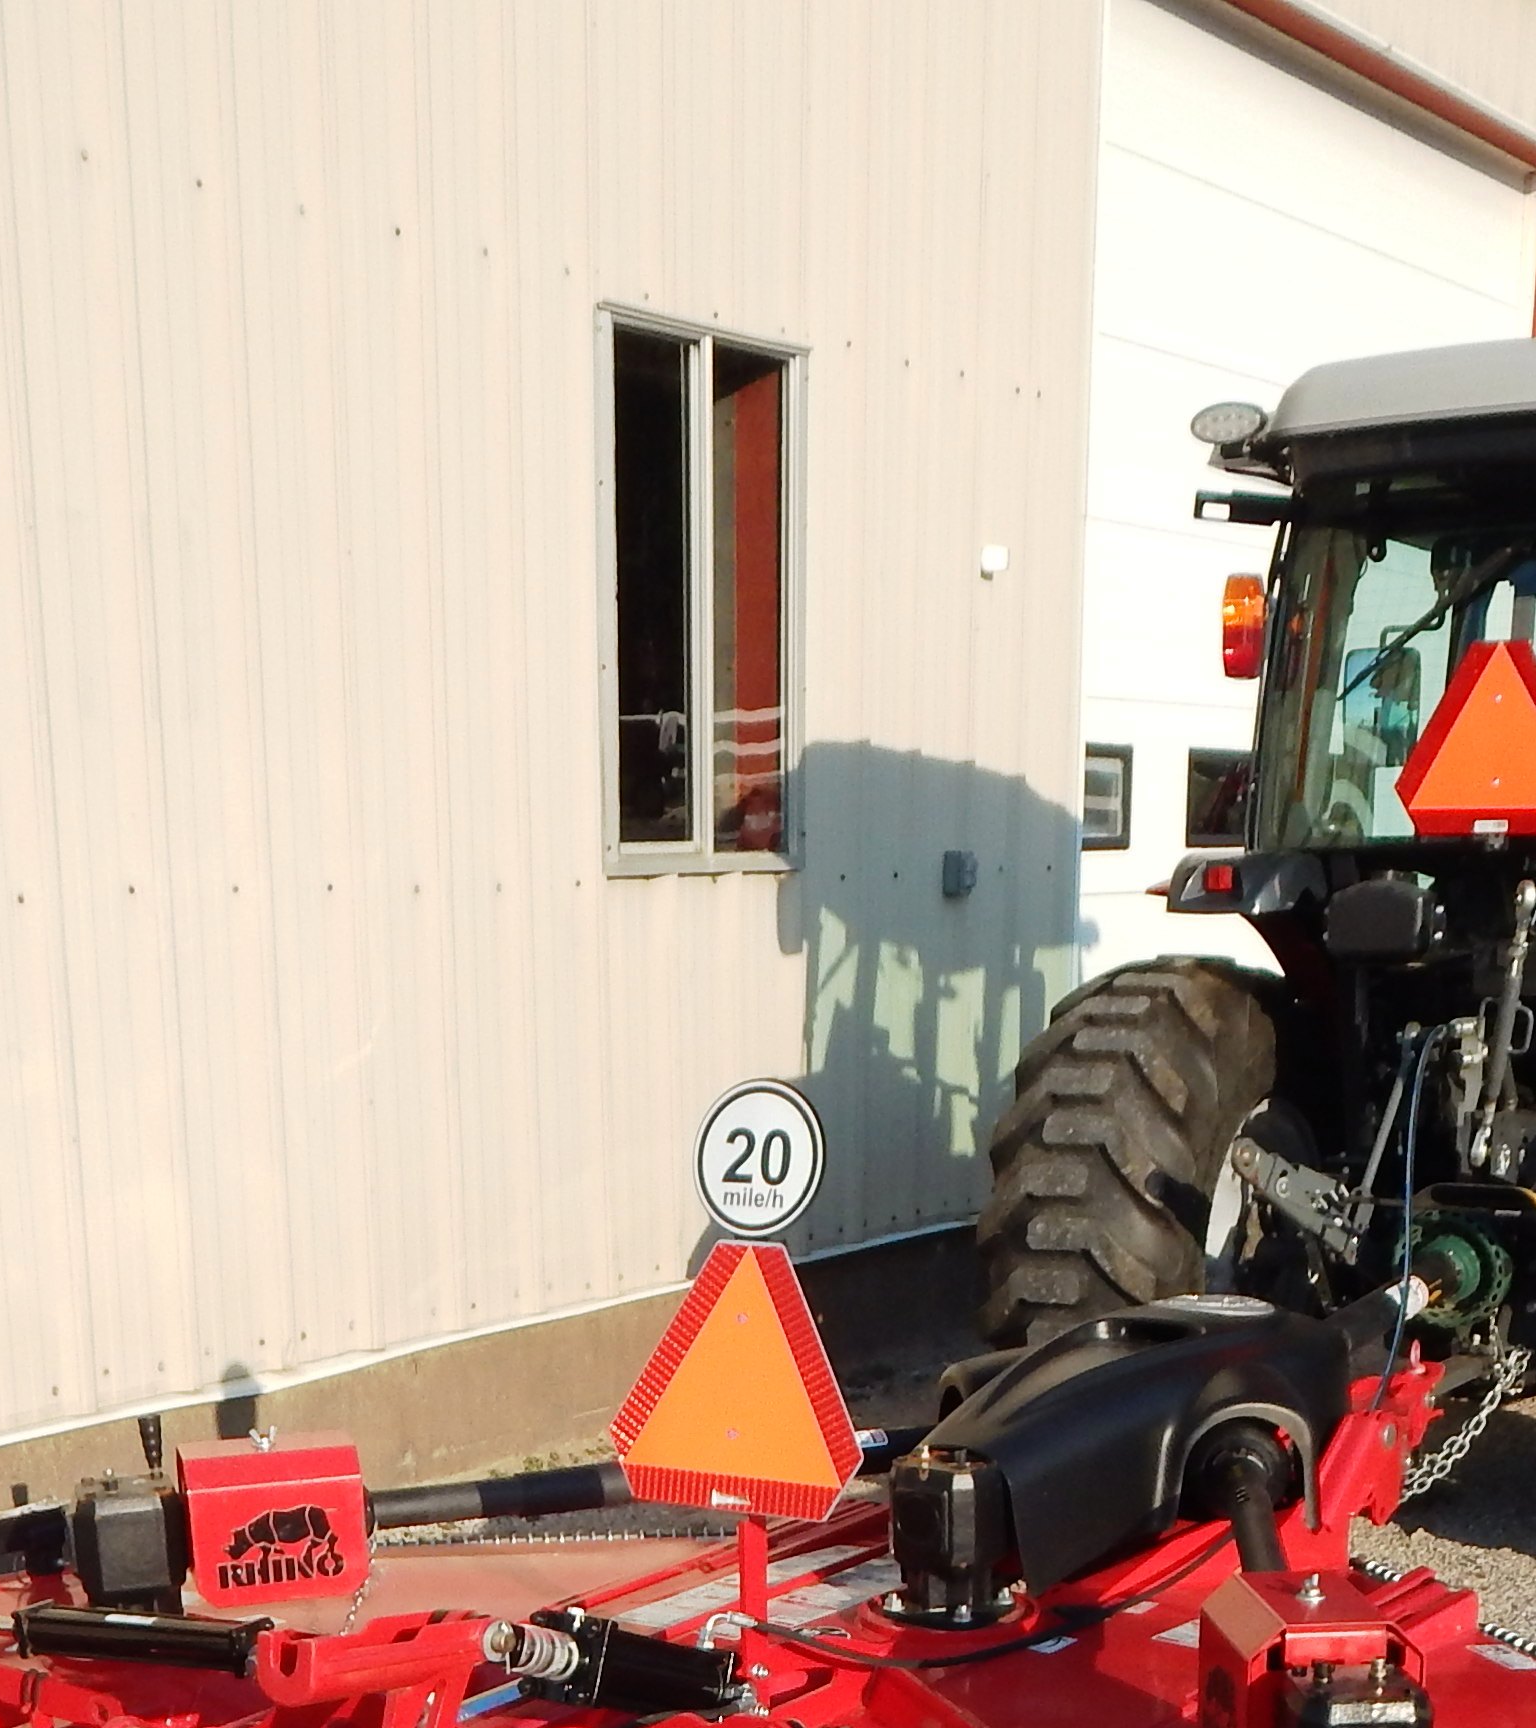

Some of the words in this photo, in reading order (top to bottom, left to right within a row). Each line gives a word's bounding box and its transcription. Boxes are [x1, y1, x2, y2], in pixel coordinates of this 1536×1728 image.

[721, 1126, 792, 1187] 20
[722, 1187, 784, 1210] mile/h
[217, 1550, 345, 1590] RHINO
